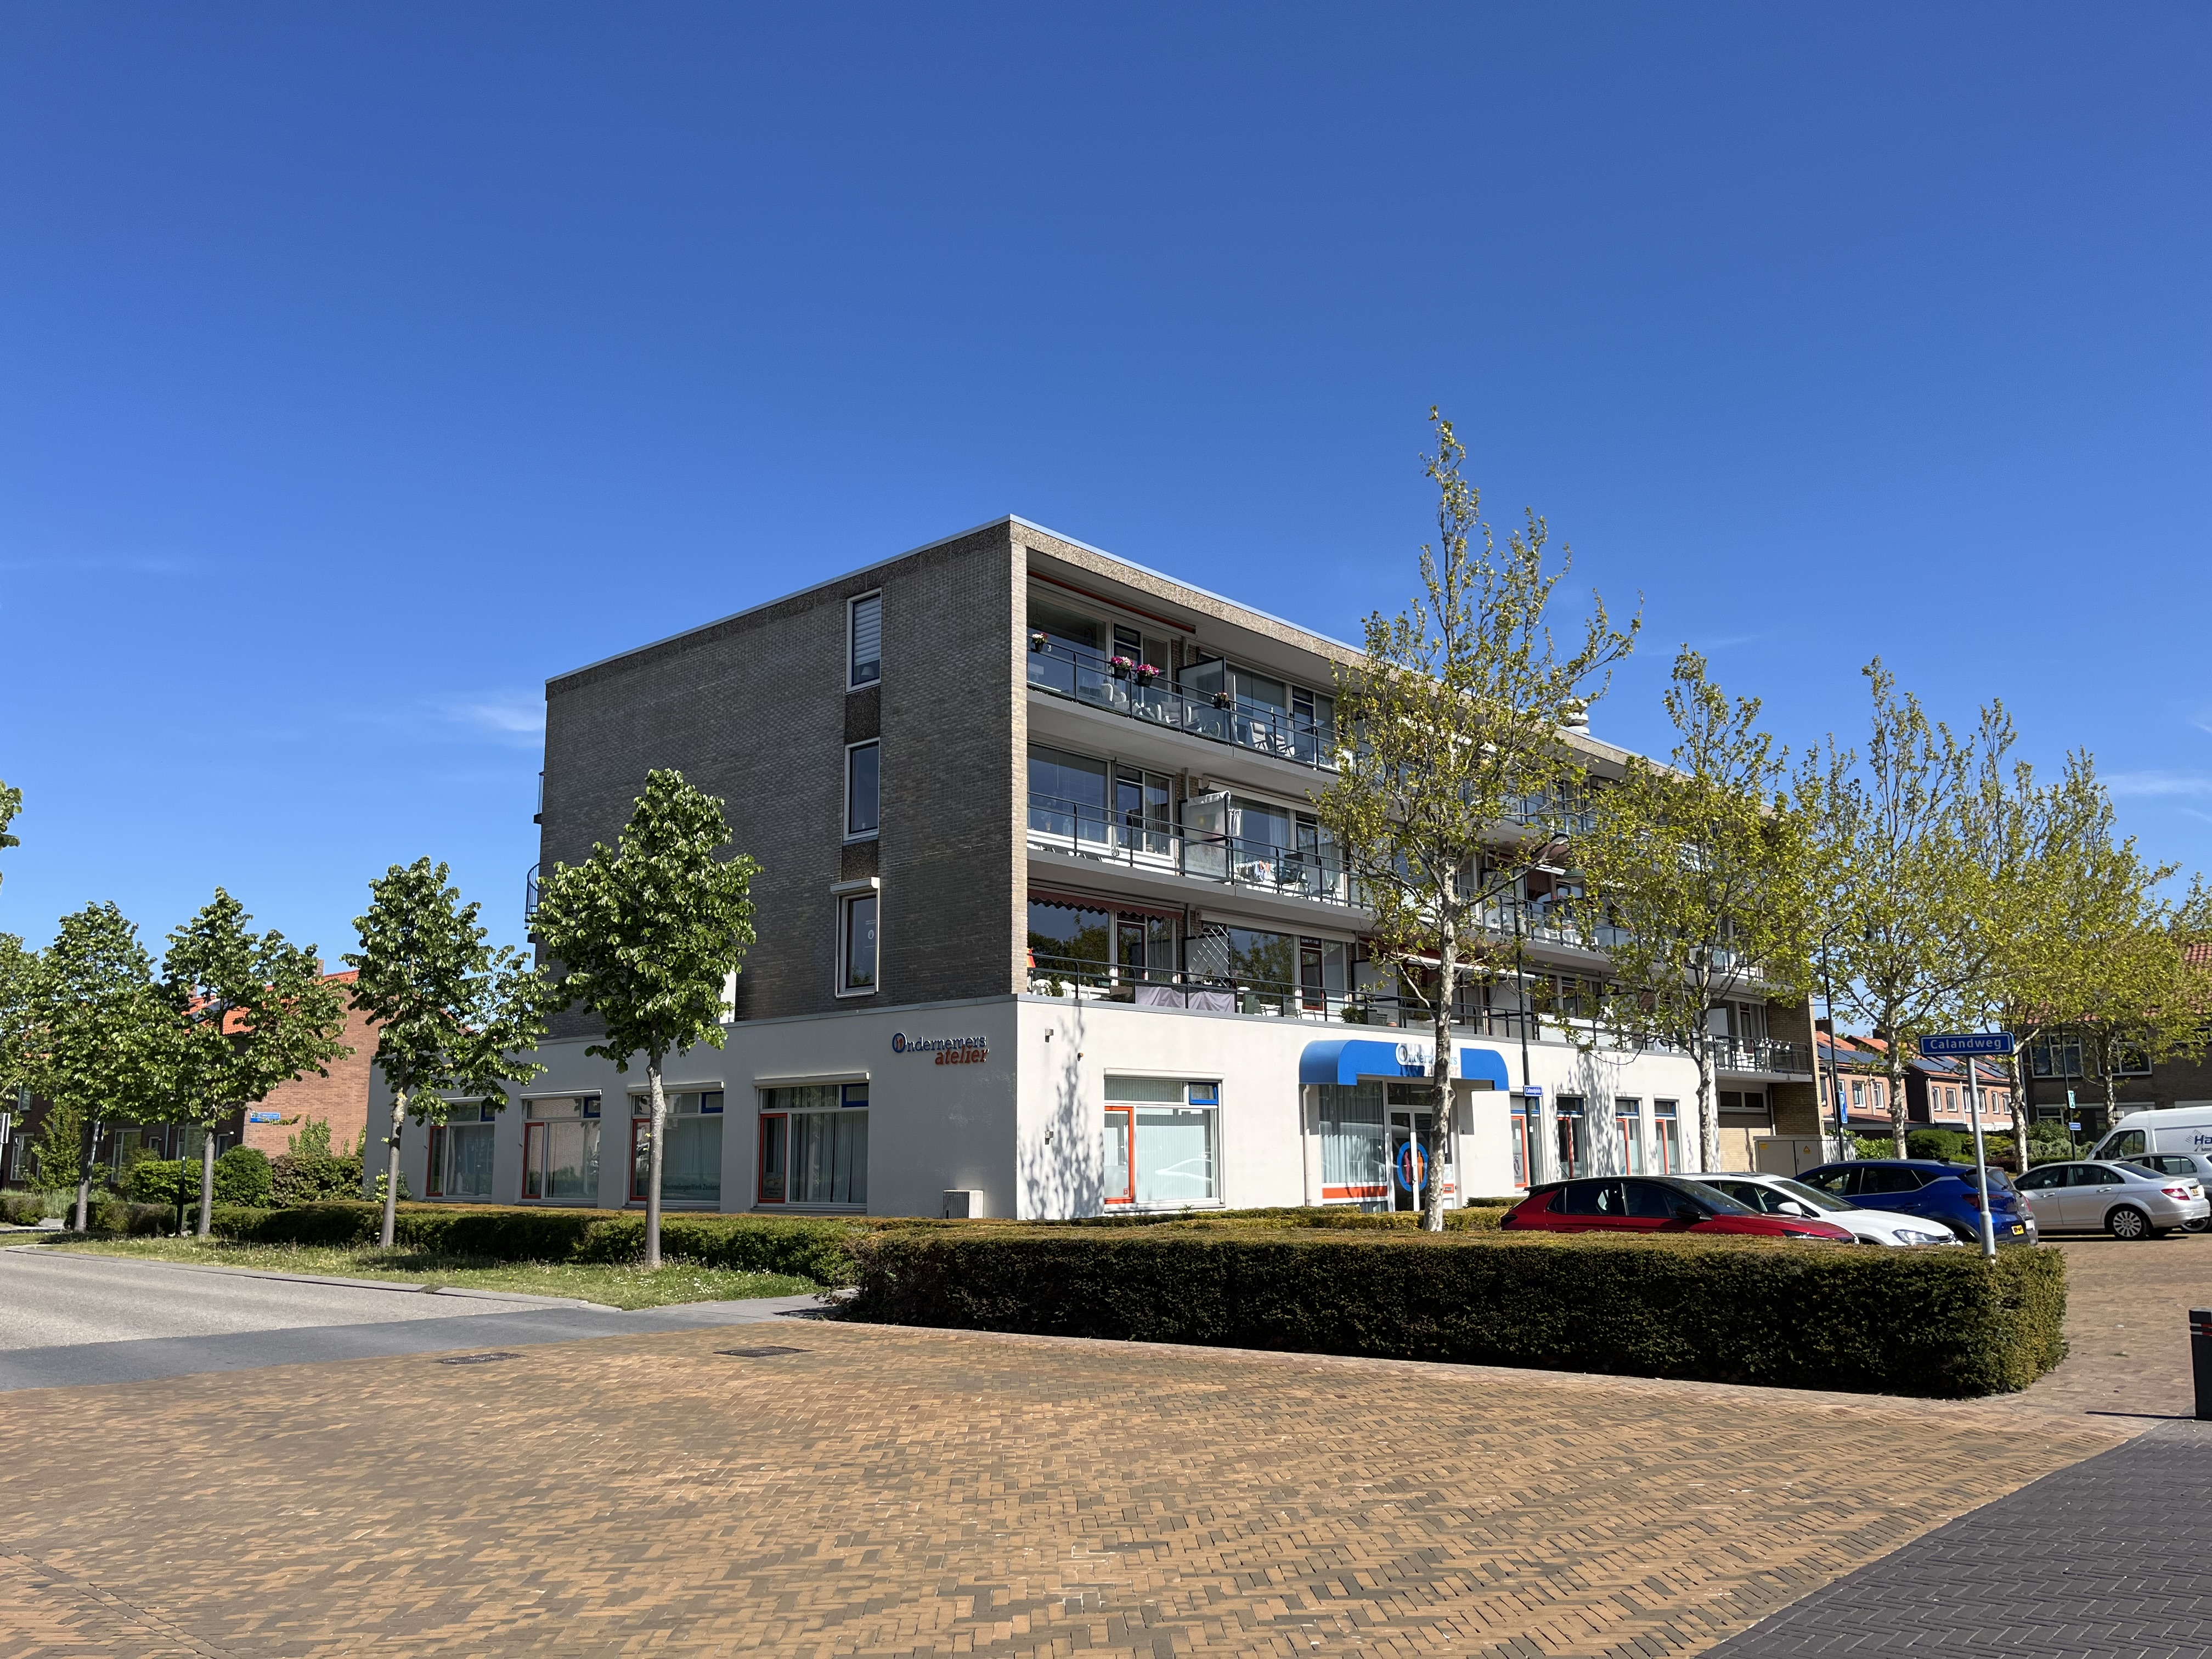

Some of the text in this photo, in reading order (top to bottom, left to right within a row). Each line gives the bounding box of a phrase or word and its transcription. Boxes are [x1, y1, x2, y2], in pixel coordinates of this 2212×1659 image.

[892, 1032, 986, 1053] Ondernemers
[1930, 1039, 2001, 1050] Calandweg
[935, 1045, 989, 1065] atelier
